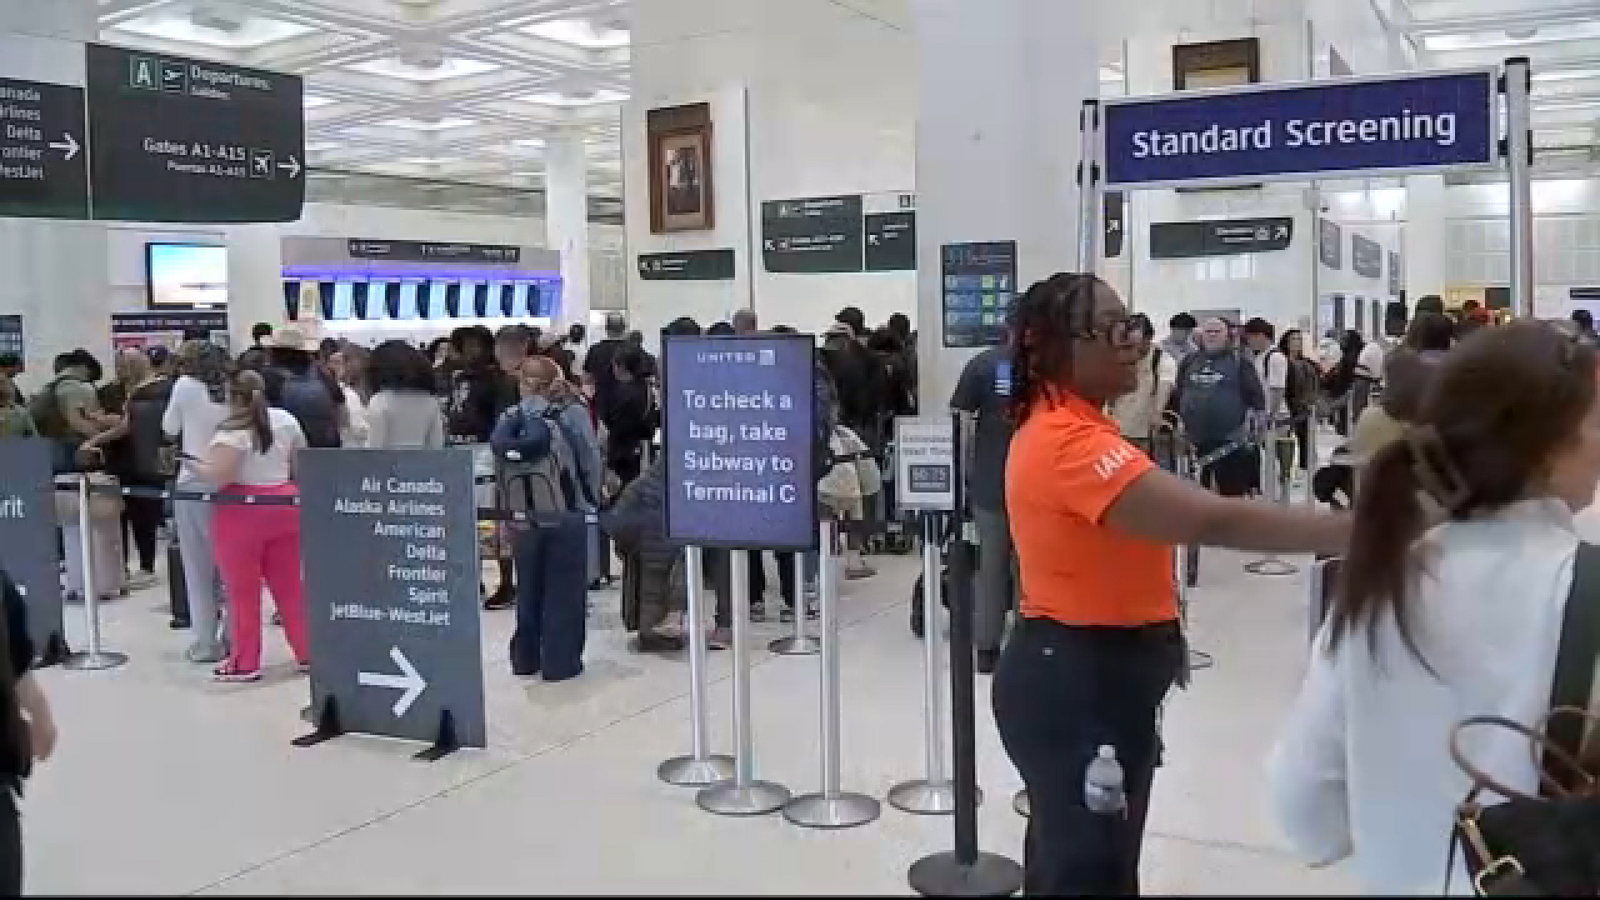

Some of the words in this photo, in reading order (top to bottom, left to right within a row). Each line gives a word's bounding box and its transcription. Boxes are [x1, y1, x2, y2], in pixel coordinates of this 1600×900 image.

[136, 61, 152, 86] A
[190, 65, 273, 90] Departures
[7, 124, 41, 141] Delta
[1131, 119, 1272, 159] Standard
[1285, 109, 1457, 147] Screening
[0, 145, 42, 160] ontier
[143, 137, 187, 156] Gates
[191, 142, 246, 161] A1-A15
[696, 351, 756, 364] UNITED
[682, 389, 706, 409] To
[709, 389, 775, 410] check
[779, 393, 793, 410] a
[689, 420, 735, 445] bag,
[739, 421, 787, 442] take
[683, 450, 767, 475] Subway
[771, 454, 794, 473] to
[361, 476, 381, 493] Air
[387, 476, 444, 494] Canada
[682, 481, 774, 504] Terminal
[779, 483, 796, 504] C
[334, 497, 383, 514] Alaska
[386, 498, 446, 516] Airlines
[373, 520, 446, 539] American
[406, 543, 446, 561] Delta
[388, 563, 446, 582] Frontier
[409, 586, 449, 605] Spirit
